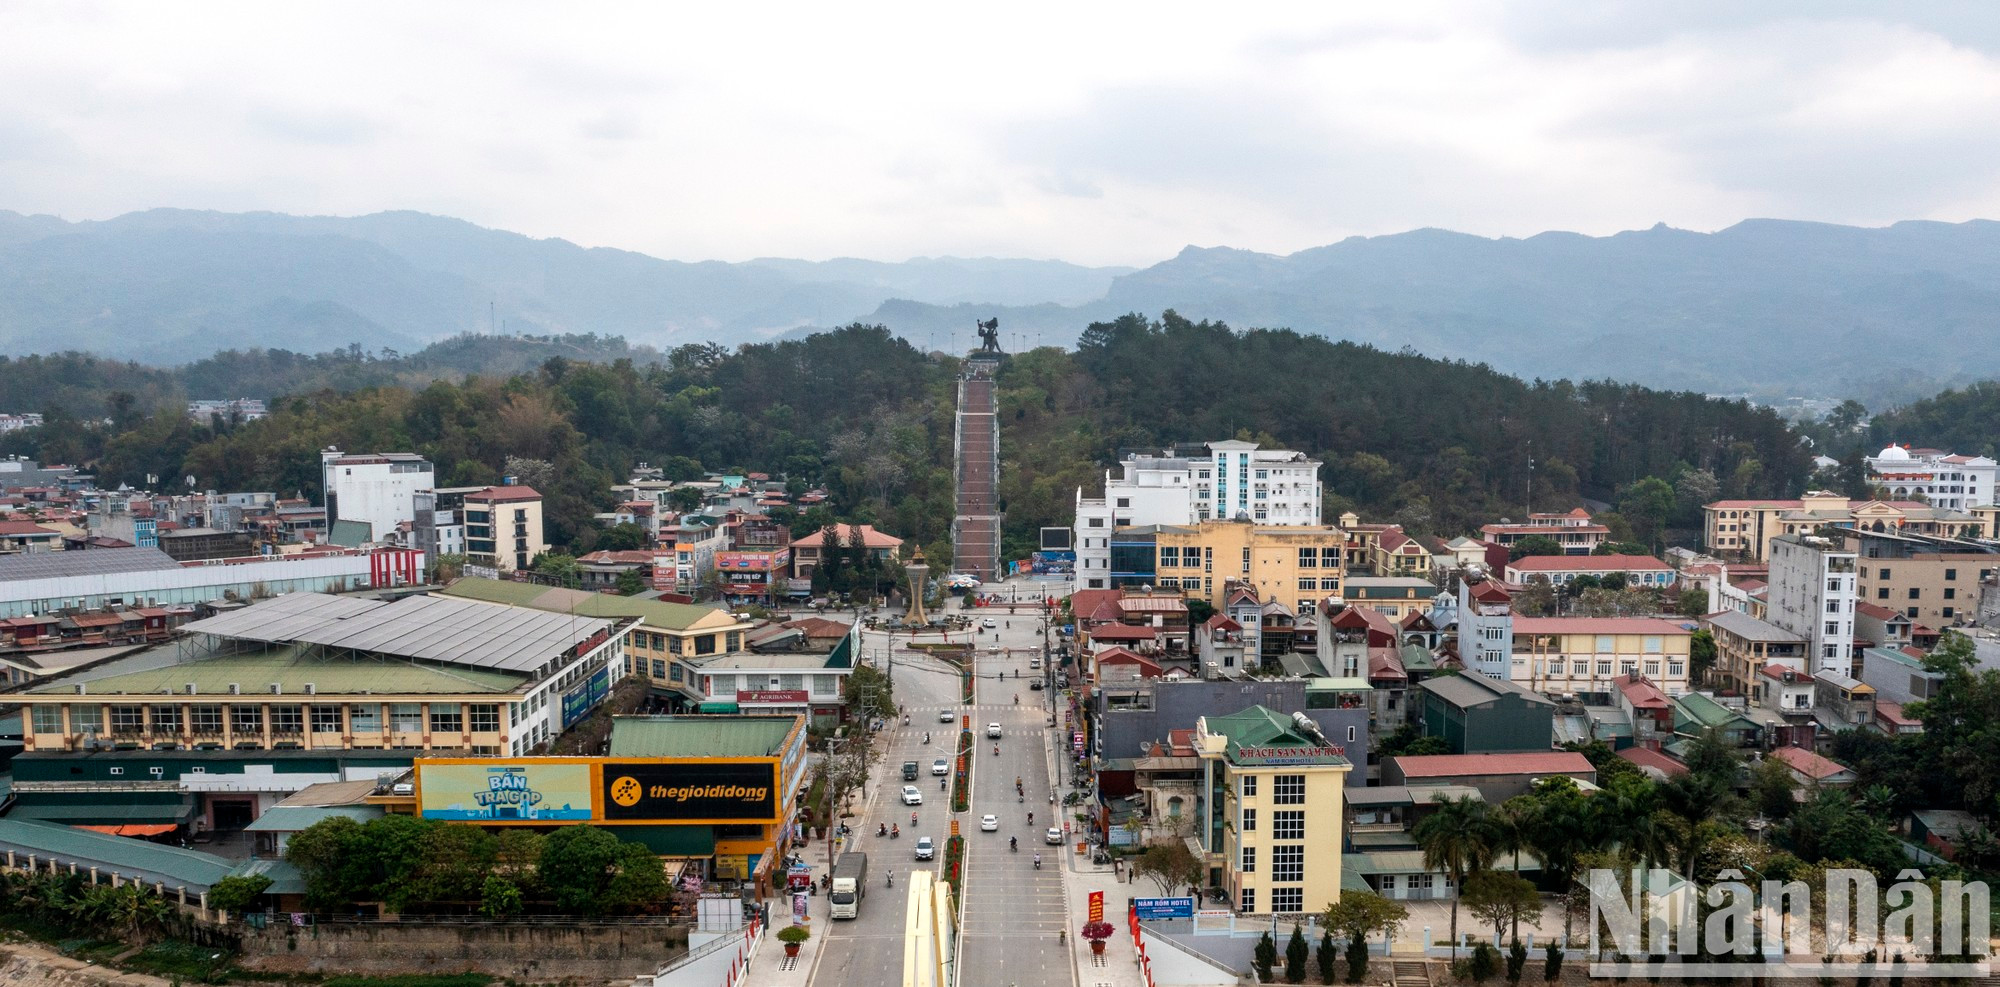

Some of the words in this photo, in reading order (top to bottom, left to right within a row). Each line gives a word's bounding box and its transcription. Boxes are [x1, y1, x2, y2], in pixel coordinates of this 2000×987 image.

[488, 772, 527, 791] BÁN
[474, 788, 508, 806] TRẢ
[508, 788, 542, 806] GÓP
[650, 785, 767, 801] thegioididong
